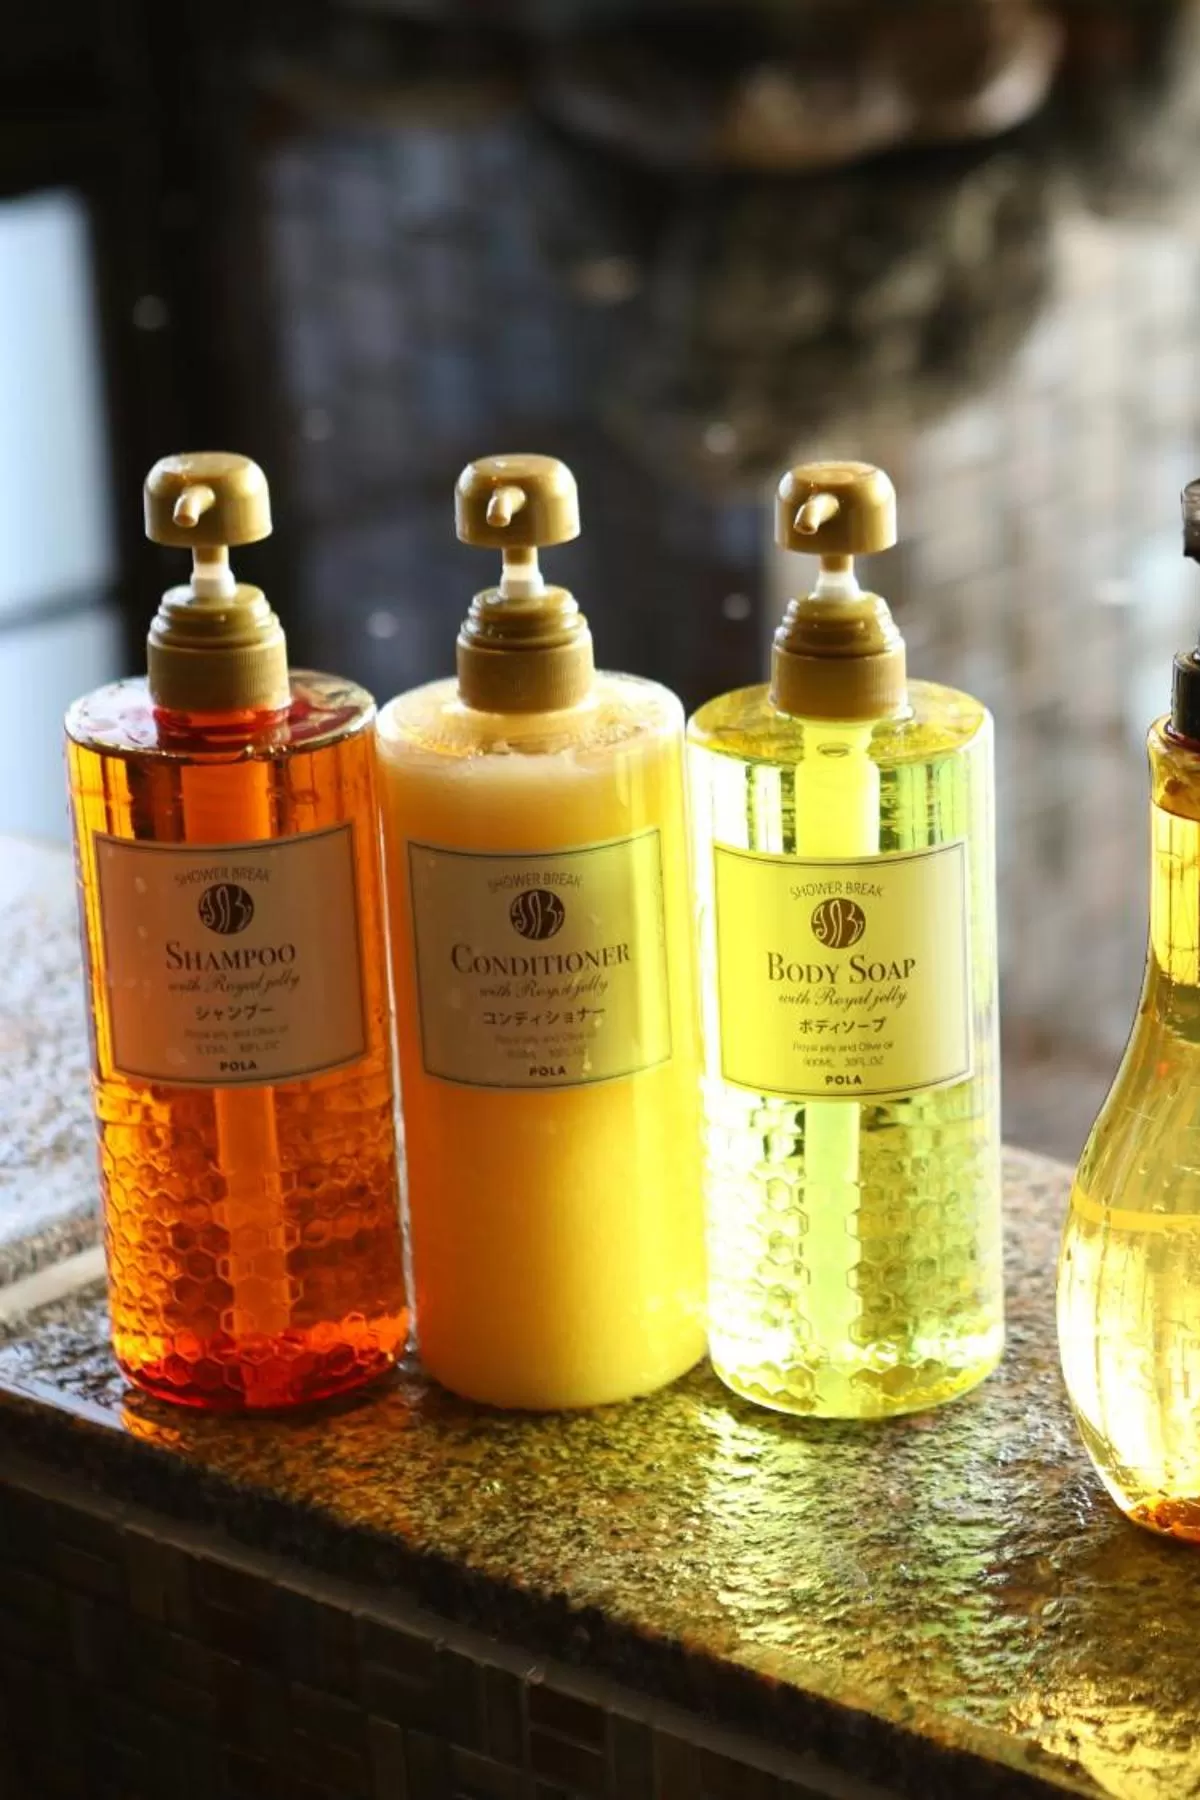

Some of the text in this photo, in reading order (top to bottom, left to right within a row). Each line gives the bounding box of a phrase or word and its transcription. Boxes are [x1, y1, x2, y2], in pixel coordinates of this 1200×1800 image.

[174, 866, 272, 888] SHOWER BREAK
[488, 872, 582, 893] SHOWER BREAK
[790, 881, 885, 900] SHOWER BREAK
[166, 940, 296, 972] SHAMPOO
[451, 943, 631, 977] CONDITIONER
[767, 952, 916, 985] BODY SOAP
[168, 969, 300, 998] with Royal jelly
[480, 974, 608, 1000] with Royal jelly
[779, 985, 907, 1012] with Royal jelly
[196, 1004, 274, 1021] シャンプー
[483, 1007, 605, 1027] コンディショナー
[799, 1016, 887, 1034] ボディソープ
[219, 1061, 257, 1072] POLA
[529, 1066, 566, 1077] POLA
[825, 1074, 862, 1086] POLA
